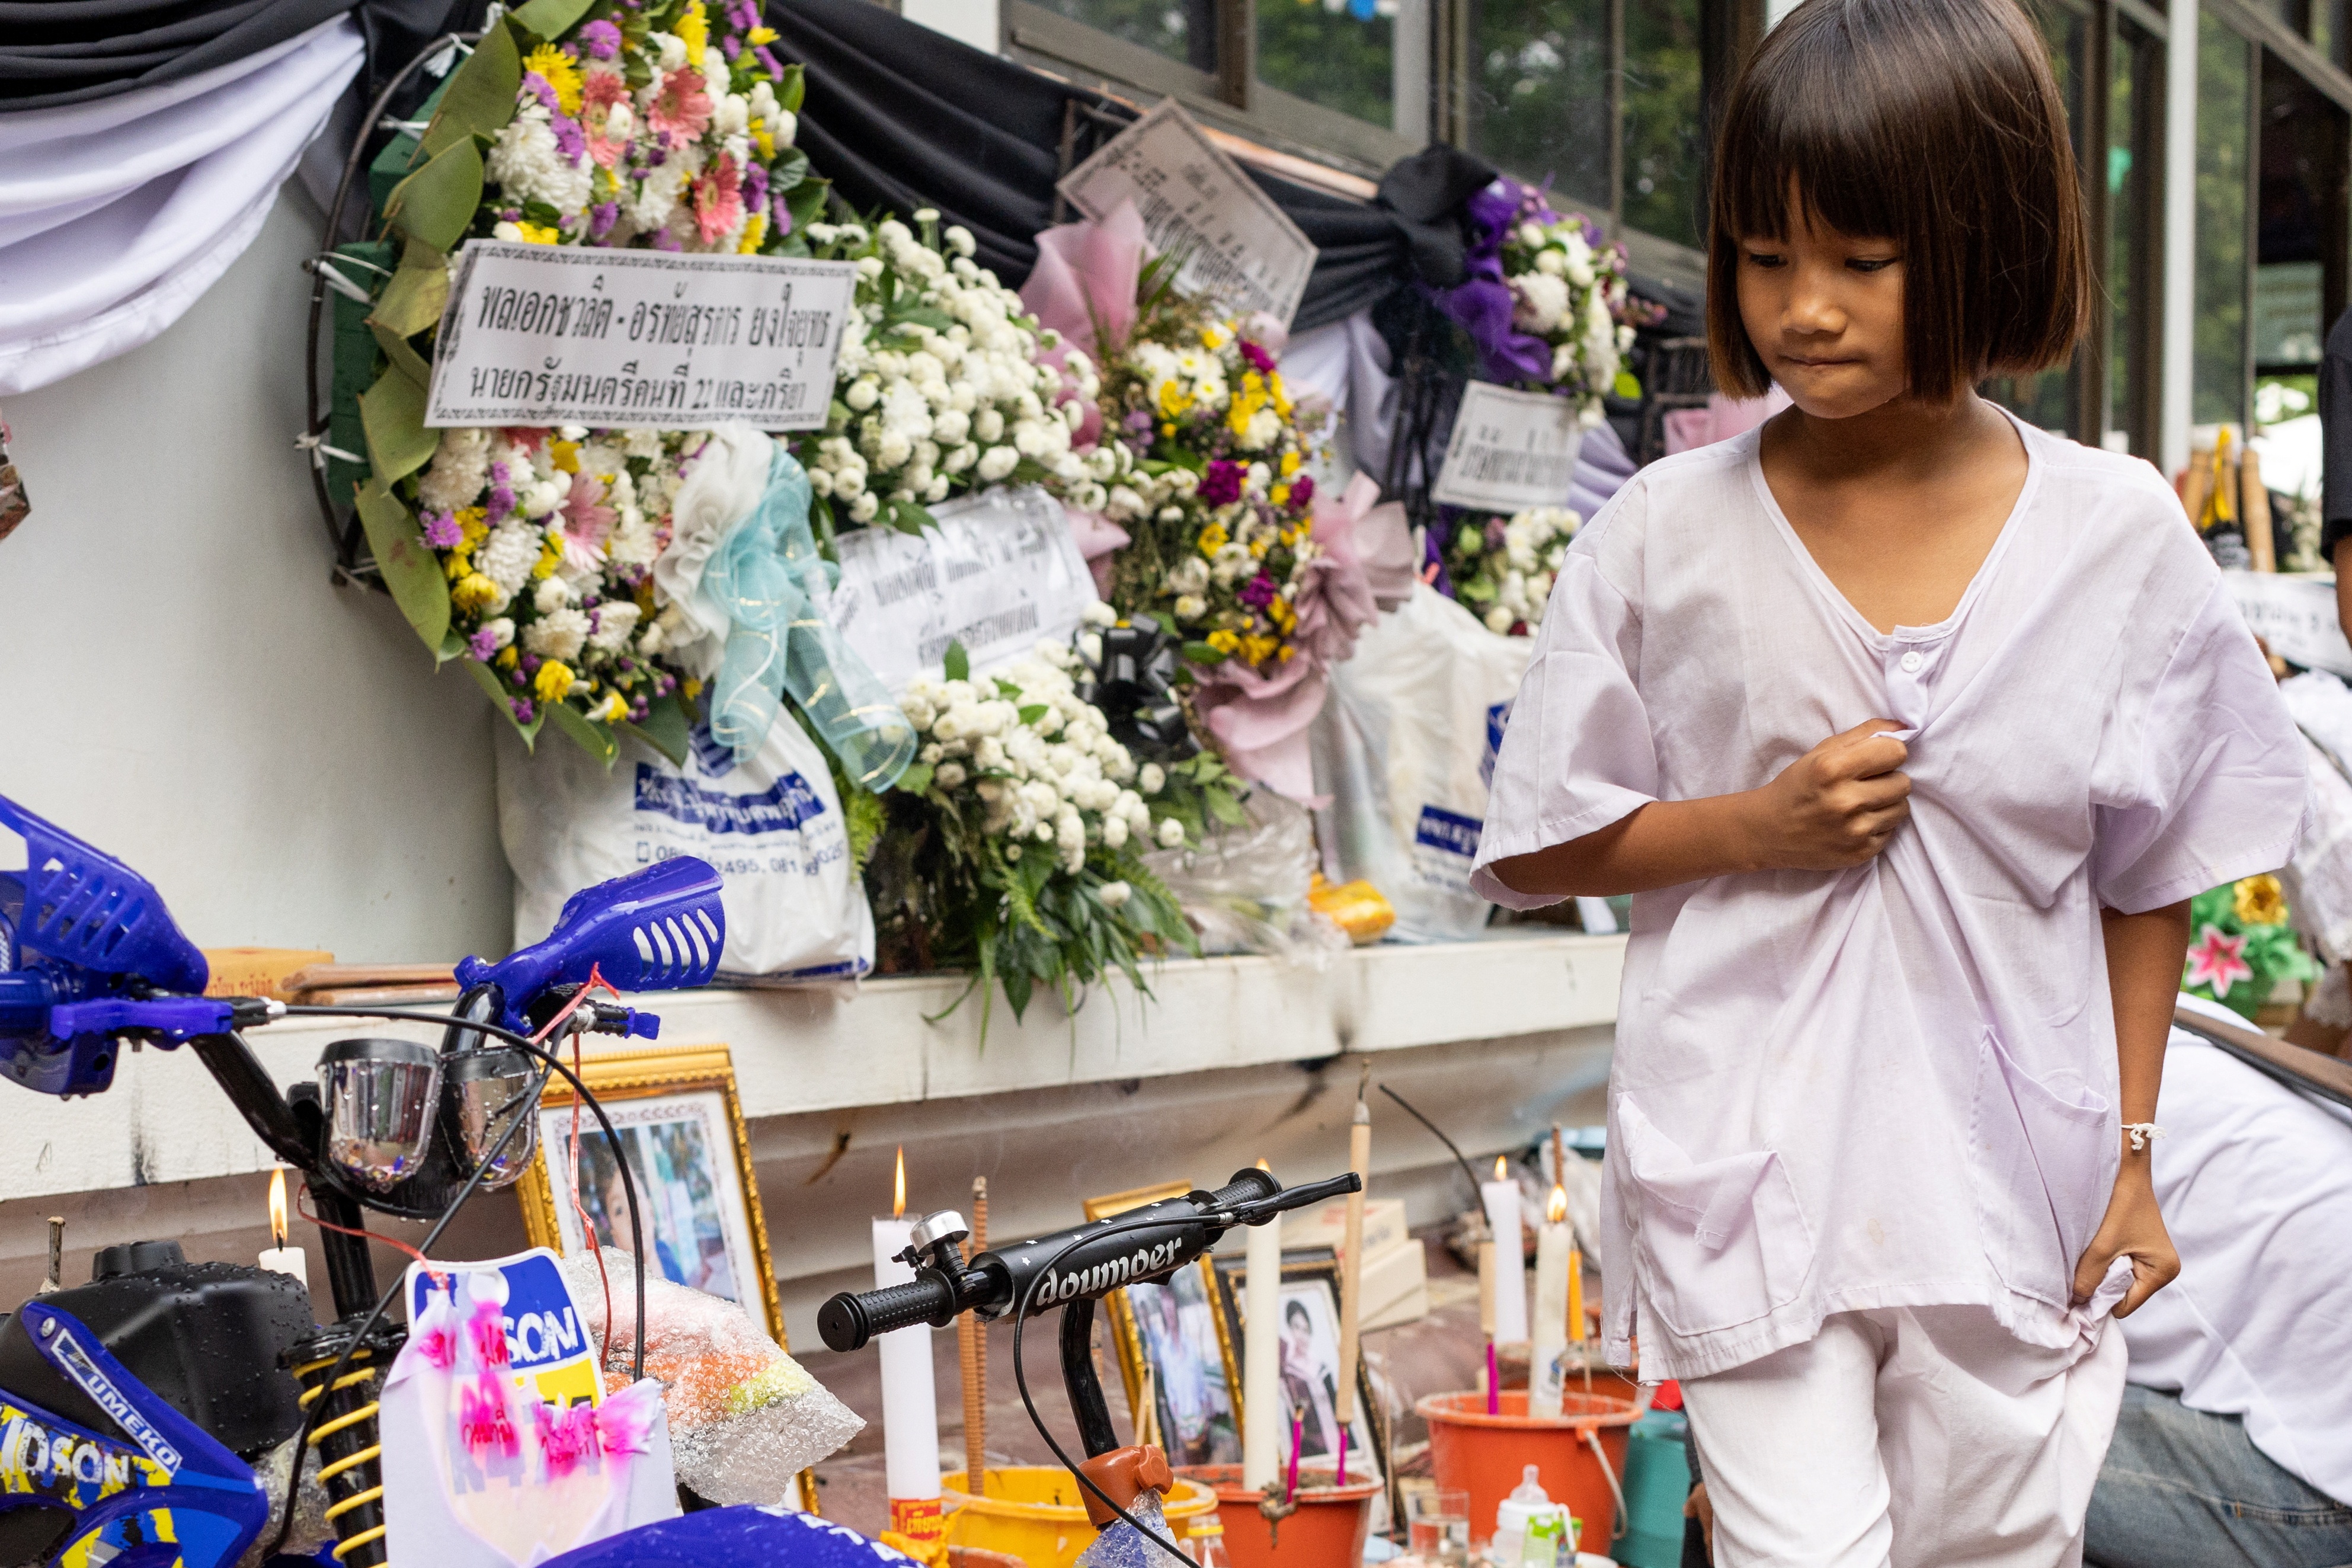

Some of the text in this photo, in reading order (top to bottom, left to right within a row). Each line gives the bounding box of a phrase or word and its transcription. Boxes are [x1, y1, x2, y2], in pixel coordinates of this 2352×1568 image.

[1037, 1237, 1183, 1307] doumoer
[0, 1415, 130, 1485] IDSON
[87, 1377, 179, 1469] UMEKO
